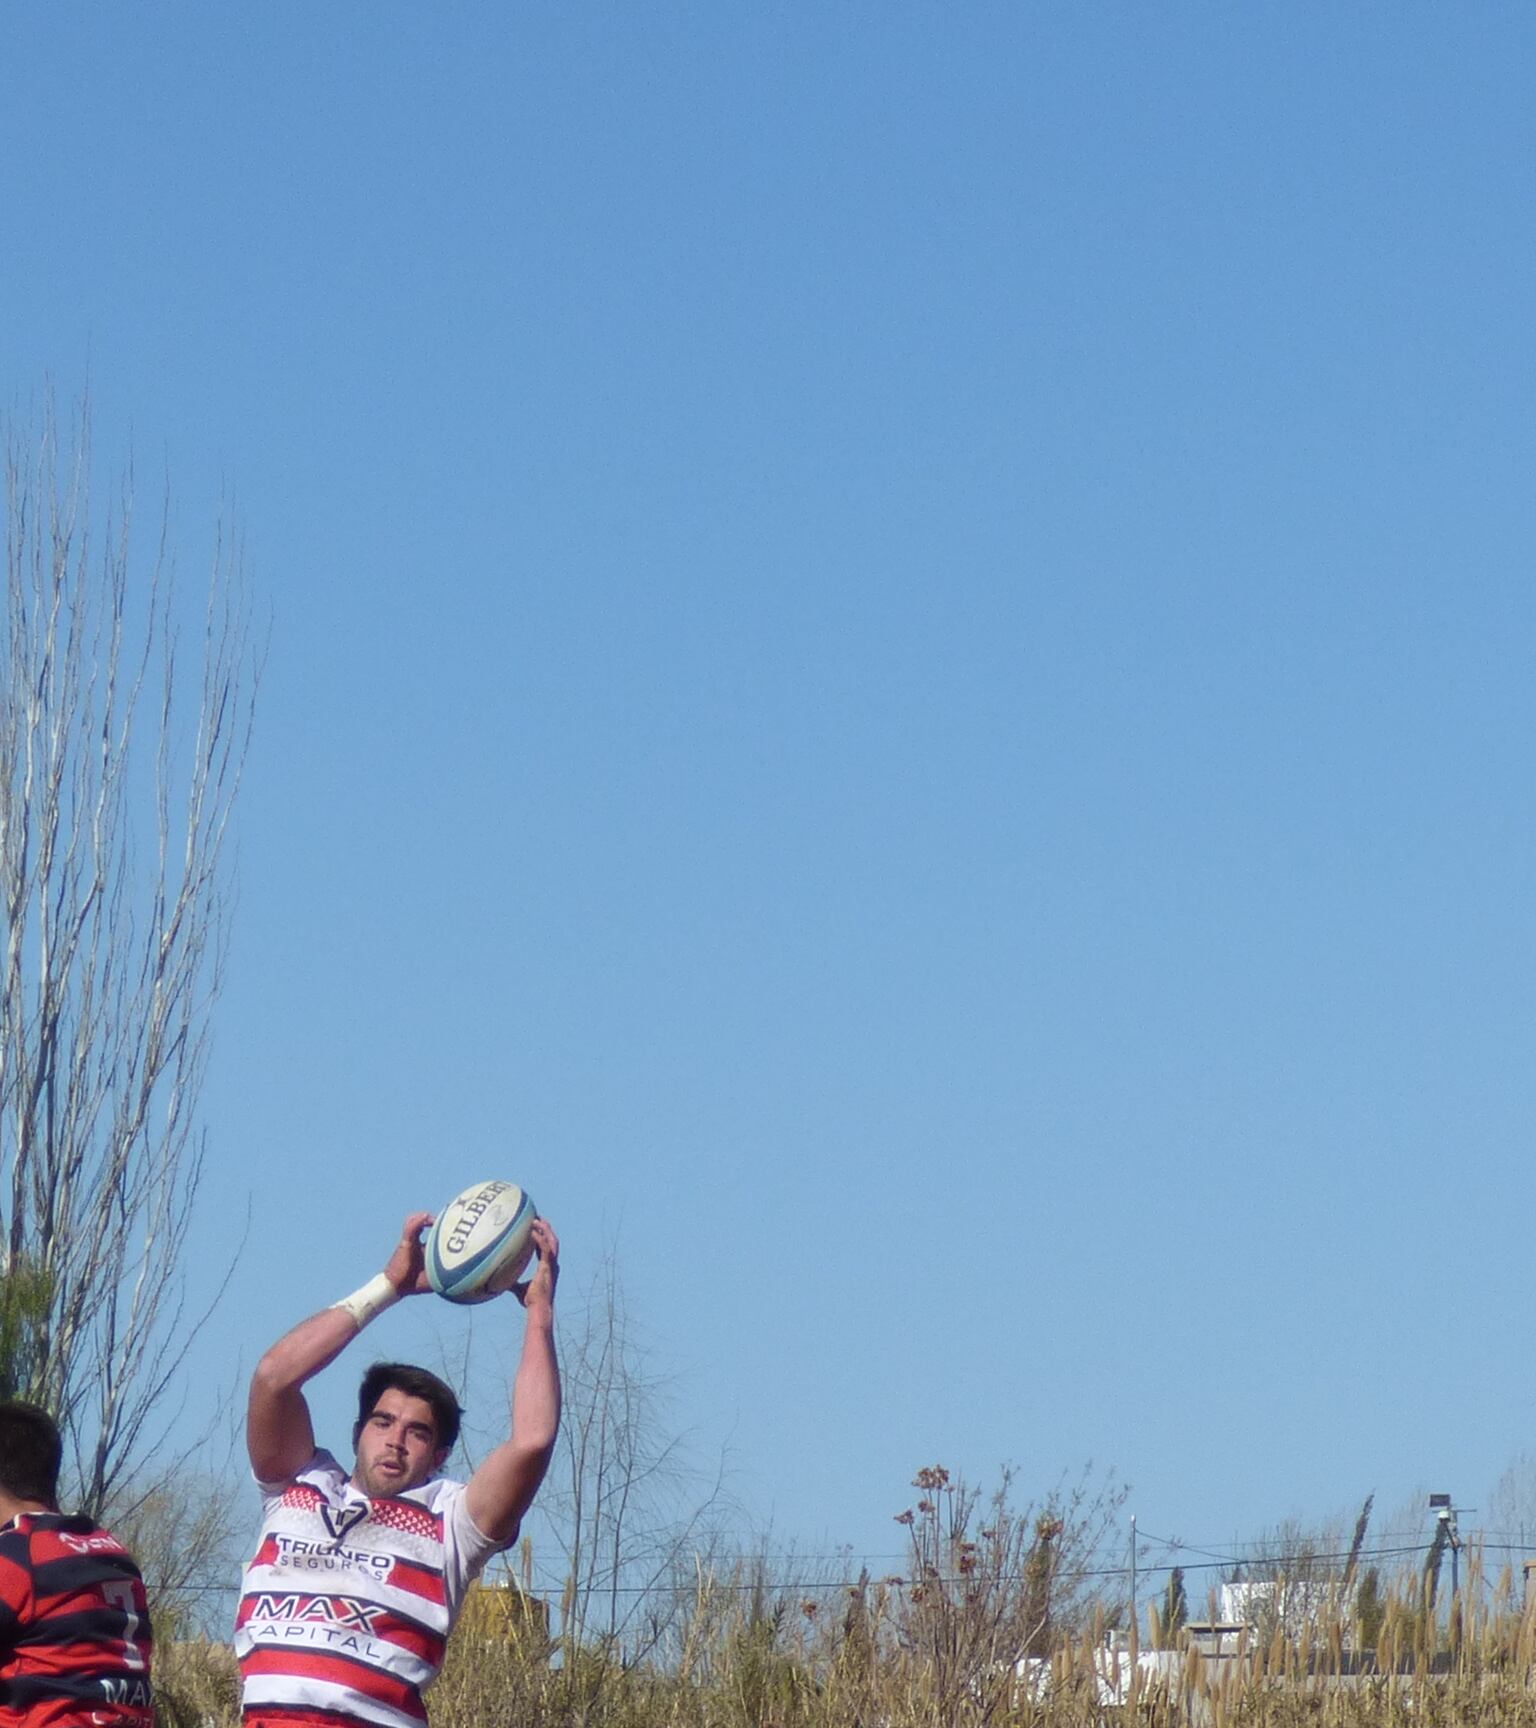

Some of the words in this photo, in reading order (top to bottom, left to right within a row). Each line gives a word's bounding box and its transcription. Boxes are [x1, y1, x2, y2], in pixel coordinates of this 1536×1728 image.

[279, 1537, 391, 1569] TRIUNFO
[280, 1555, 384, 1582] SEGUROS
[253, 1595, 386, 1637] MAX
